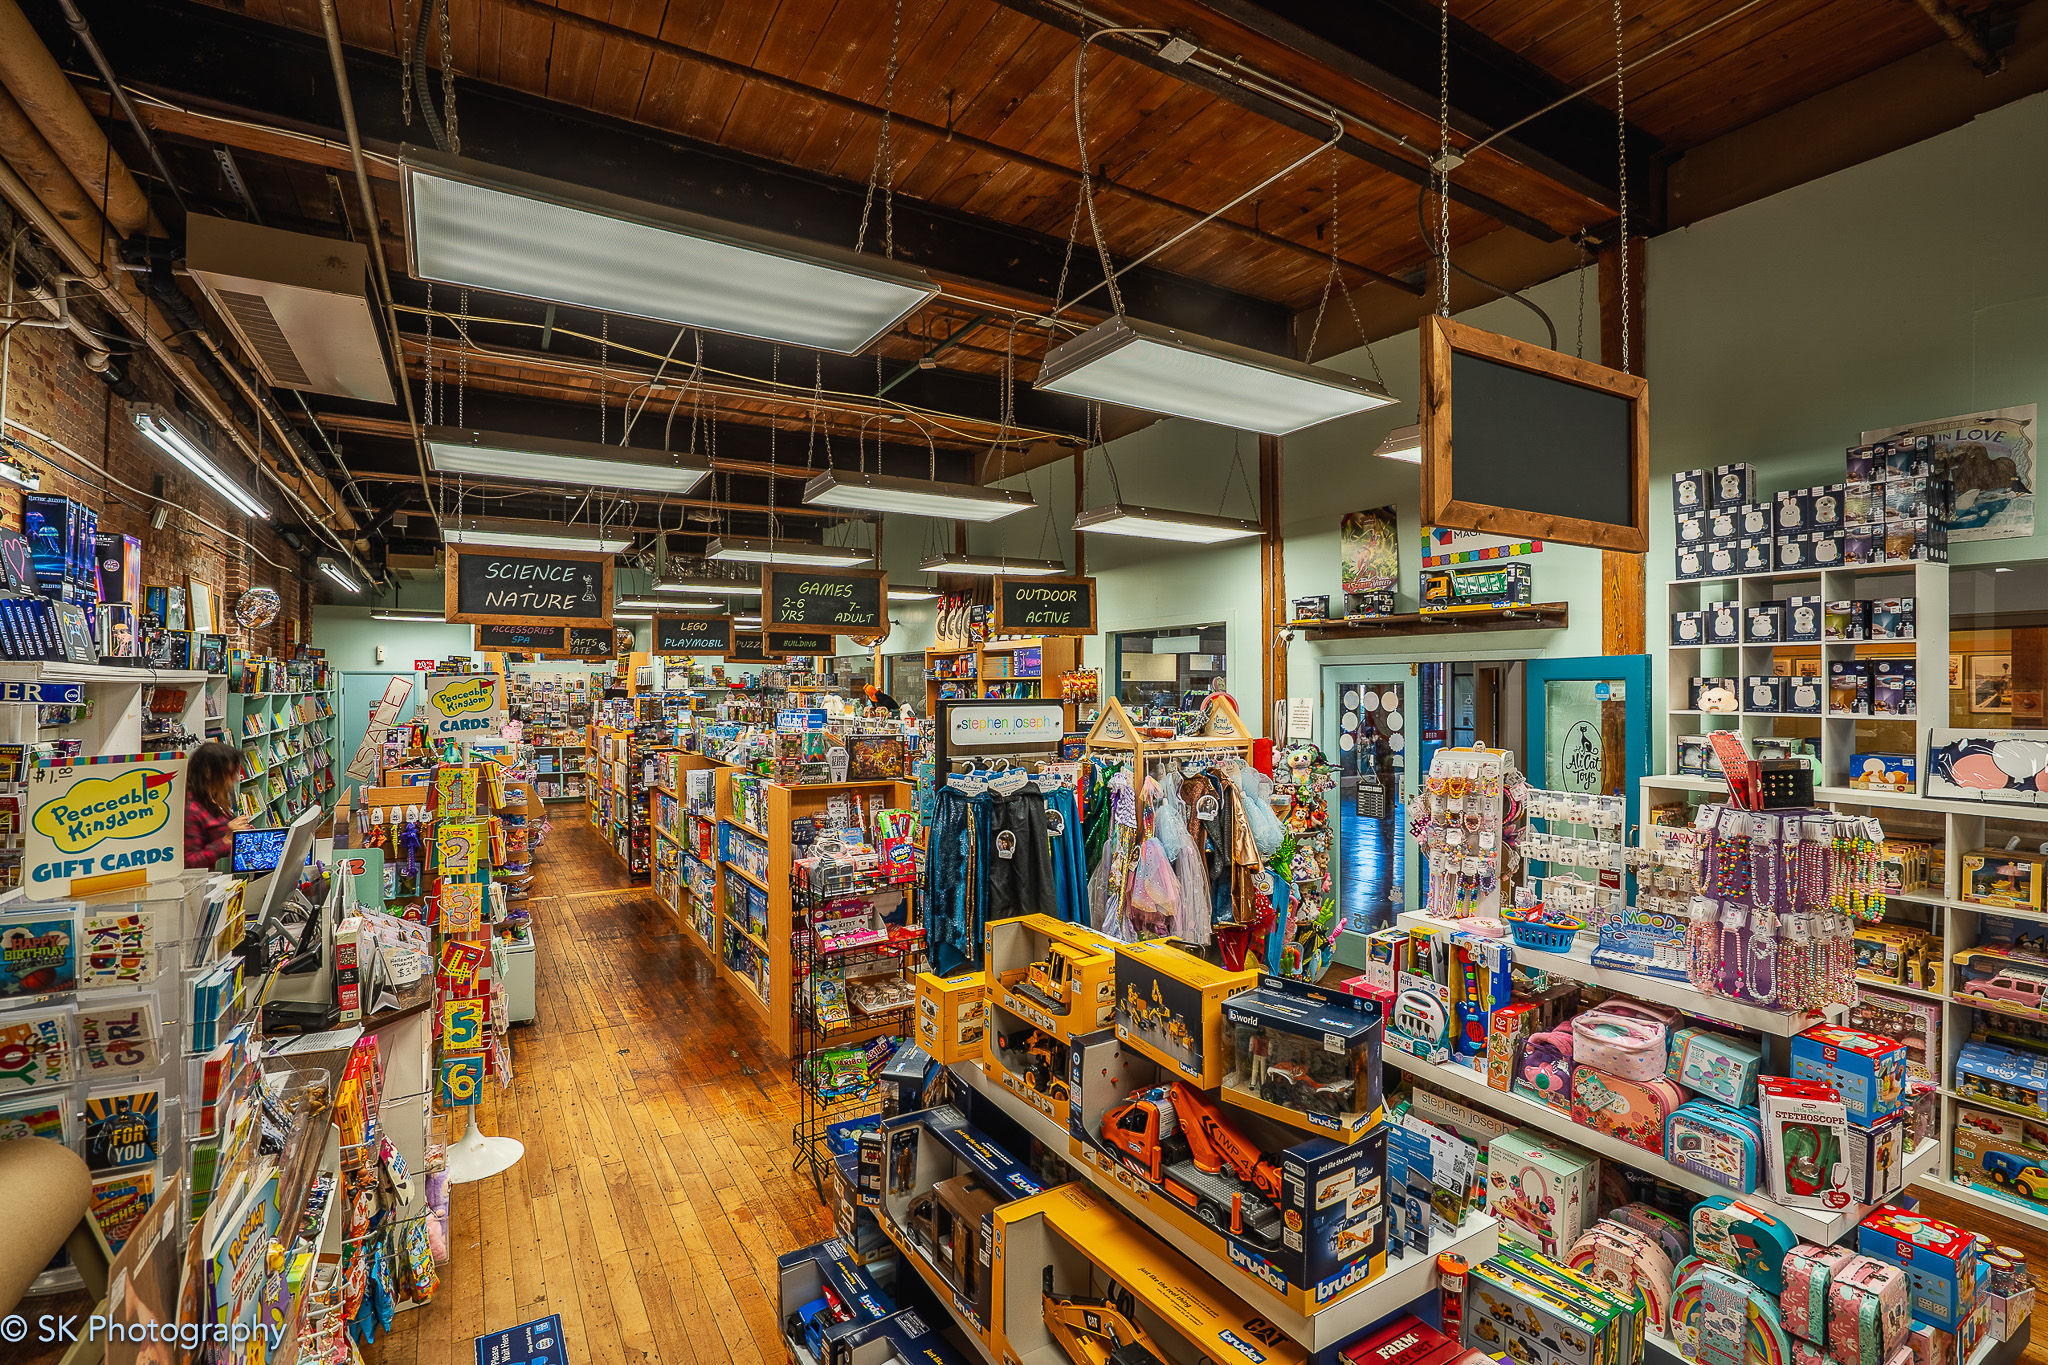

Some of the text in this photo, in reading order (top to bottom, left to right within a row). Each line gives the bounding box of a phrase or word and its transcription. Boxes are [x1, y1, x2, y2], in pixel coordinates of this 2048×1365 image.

[1919, 420, 1969, 433] JAN BRETT
[1938, 428, 2008, 443] IN LOVE
[485, 562, 577, 582] SCIENCE
[798, 581, 853, 598] GAMES
[1016, 588, 1077, 602] OUTDOOR
[485, 590, 577, 610] NATURE
[782, 597, 805, 608] 2-6
[848, 601, 861, 612] 7-
[780, 609, 805, 622] YRS
[834, 612, 875, 624] ADULT
[1026, 611, 1071, 623] ACTIVE
[491, 625, 555, 635] ACCESSORIES
[680, 621, 708, 632] LEGO
[511, 635, 530, 644] SPA
[569, 637, 598, 647] RAFTS
[664, 636, 724, 649] PLAYMOBIL
[783, 638, 817, 649] BUILDING
[2, 684, 42, 702] ER
[439, 680, 488, 705] Peaceable
[447, 696, 486, 712] Kingdom
[440, 718, 490, 733] CARDS
[961, 715, 1050, 732] stephen joseph
[1063, 737, 1086, 745] MONSTE
[1566, 754, 1602, 772] Ali Cat
[1572, 769, 1596, 790] Toys
[50, 773, 160, 826] Peaceable
[446, 779, 468, 811] 1
[68, 804, 154, 843] Kingdom
[444, 836, 471, 868] 2
[890, 845, 911, 858] Nerds
[32, 846, 175, 883] GIFT CARDS
[449, 894, 473, 925] 3
[1621, 909, 1677, 931] MOOD
[1632, 925, 1665, 936] RINGS
[11, 934, 60, 950] HAPPY
[3, 945, 67, 962] BIRTHDAY
[443, 949, 472, 985] 4
[1400, 977, 1413, 988] hits
[451, 1007, 479, 1043] 5
[37, 1019, 62, 1083] BIRTHDAY
[84, 1016, 110, 1070] BIRTHDAY
[833, 1057, 862, 1066] HARIBO
[1179, 1061, 1199, 1078] bruder
[448, 1063, 475, 1099] 6
[1308, 1112, 1340, 1130] bruder
[1421, 1091, 1510, 1135] stephen joseph
[1775, 1110, 1845, 1125] STETHOSCOPE
[113, 1124, 145, 1147] FOR
[114, 1143, 146, 1163] YOU
[1217, 1130, 1267, 1188] TWP 450
[1317, 1150, 1363, 1175] just like the real thing
[97, 1186, 139, 1201] YOUR
[108, 1180, 131, 1192] ALL
[862, 1194, 880, 1205] bru
[231, 1224, 267, 1293] COMICTIVITY
[1601, 1254, 1627, 1271] TEA SET
[1602, 1248, 1626, 1262] MY TIN
[1228, 1240, 1286, 1291] bruder
[1137, 1265, 1193, 1309] just like the real thing
[1317, 1263, 1368, 1301] bruder
[1703, 1281, 1745, 1306] MY MUSICAL
[1710, 1291, 1736, 1309] TIN TEA
[859, 1295, 883, 1319] bruder
[953, 1294, 983, 1334] bruder
[1087, 1315, 1098, 1328] CAT
[1243, 1317, 1291, 1348] CAT
[501, 1333, 511, 1364] Wait Here
[1219, 1330, 1266, 1363] bruder
[1376, 1330, 1418, 1360] FARM
[1412, 1340, 1434, 1355] SET
[490, 1345, 500, 1365] Please
